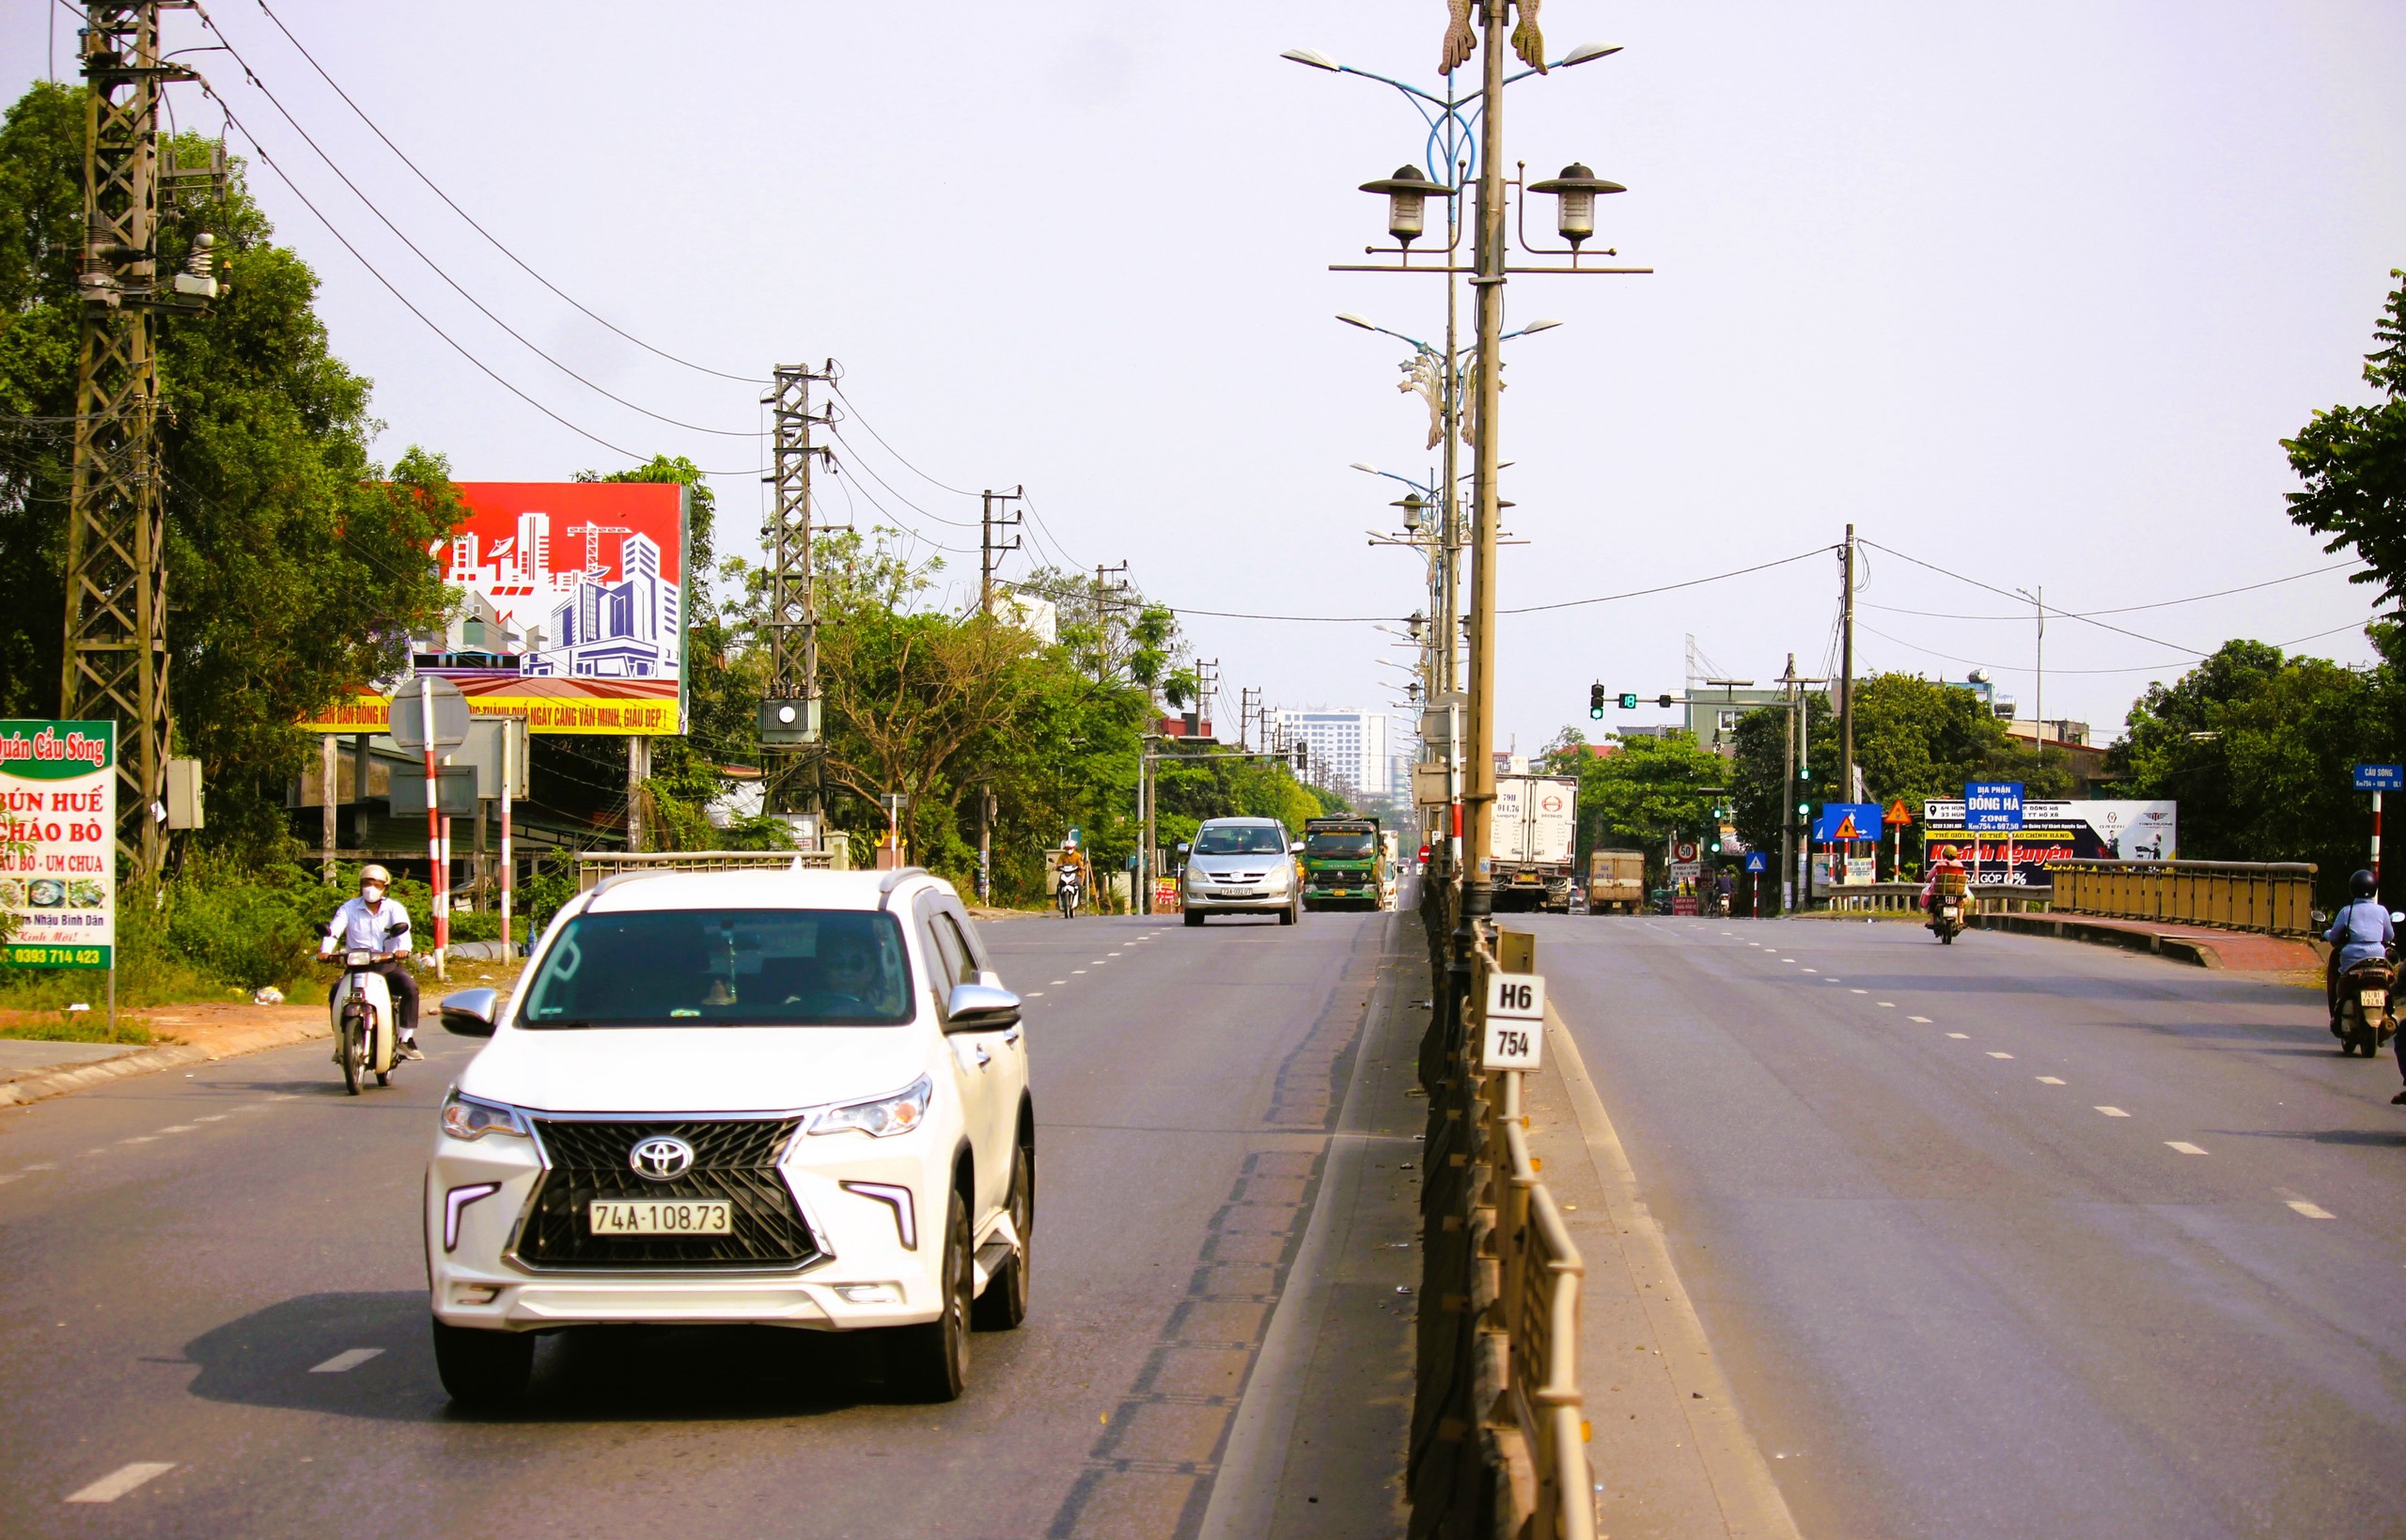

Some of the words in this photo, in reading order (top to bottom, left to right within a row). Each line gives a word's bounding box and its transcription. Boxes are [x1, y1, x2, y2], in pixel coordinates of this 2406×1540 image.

[1623, 694, 1635, 708] 18
[530, 703, 553, 726] NGÀY
[598, 708, 621, 729] MINH,
[0, 731, 32, 765] uán
[66, 731, 105, 767] Sòng
[51, 785, 103, 812] HUẾ
[1968, 795, 2001, 811] ĐÔNG
[2003, 795, 2020, 811] HÀ
[1968, 822, 1991, 831] Km754
[1979, 815, 2009, 823] ZONE
[69, 817, 102, 843] BÒ
[1680, 847, 1691, 857] 50
[1929, 844, 1994, 863] Kánh
[1979, 873, 2003, 884] GÓP
[14, 948, 46, 963] 0393
[49, 949, 73, 964] 714
[75, 950, 101, 964] 423
[1500, 983, 1532, 1009] H6
[1496, 1030, 1529, 1057] 754
[596, 1206, 726, 1231] 74A-108.73
